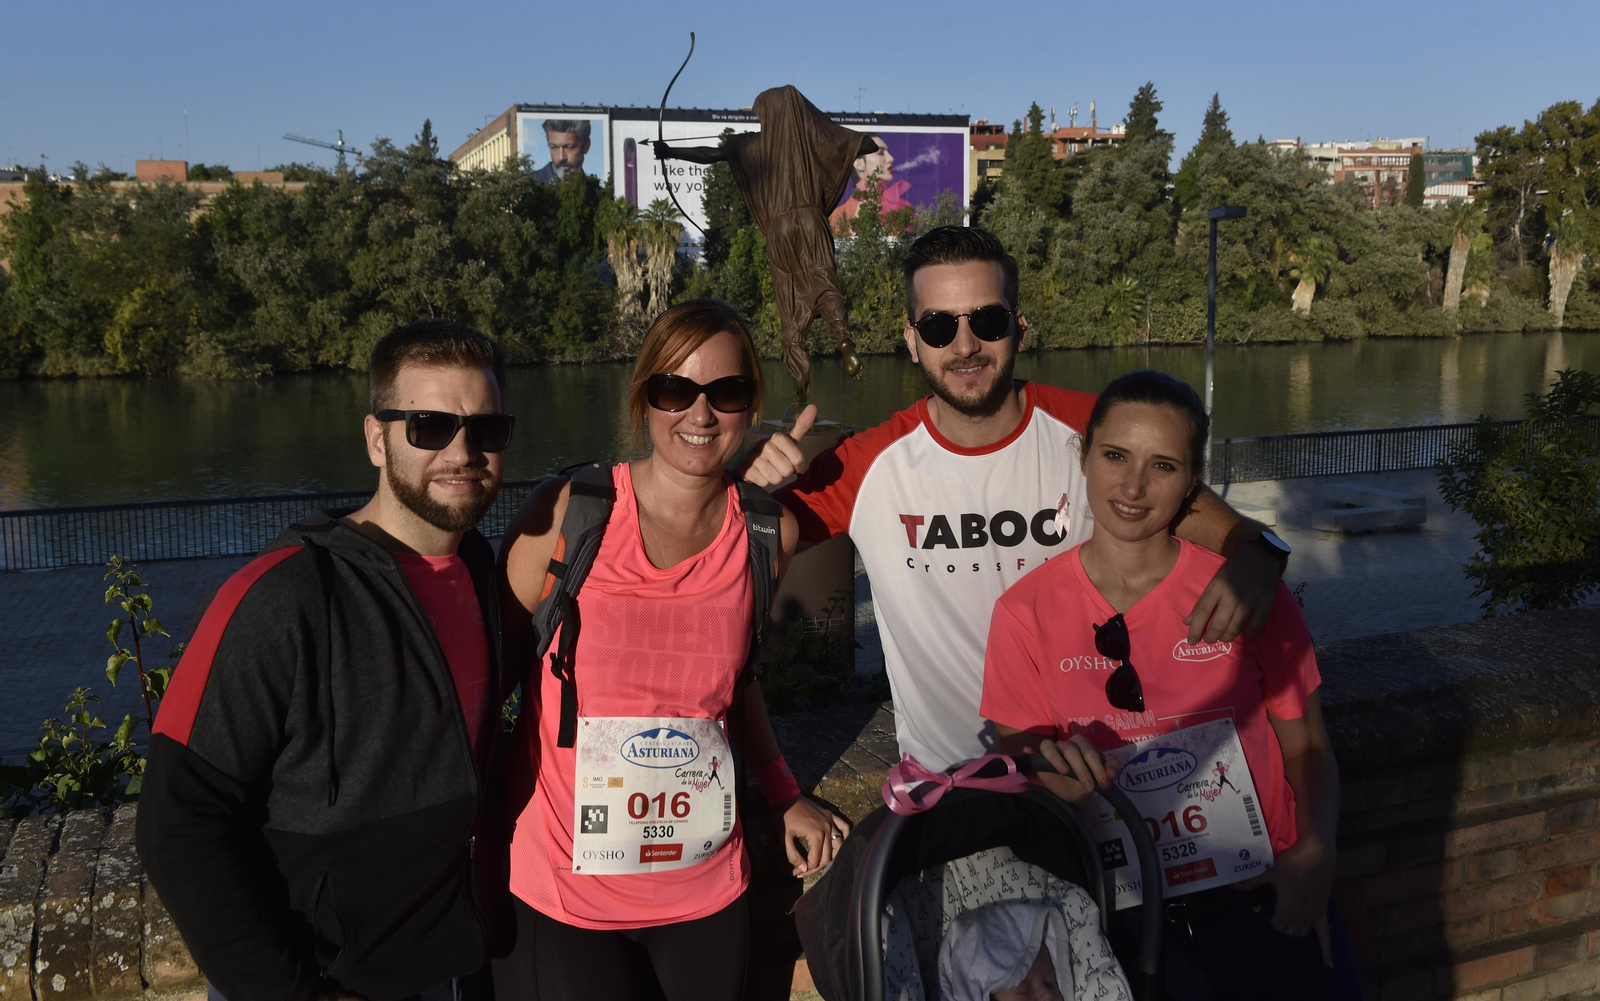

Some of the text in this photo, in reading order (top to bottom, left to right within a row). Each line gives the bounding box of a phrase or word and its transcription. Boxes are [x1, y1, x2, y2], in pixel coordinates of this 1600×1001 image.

[899, 508, 1067, 549] TABOO
[627, 742, 695, 758] ASTURIANA
[675, 768, 703, 778] Carrera
[1125, 759, 1192, 788] ASTURIANA
[1177, 779, 1209, 793] Carrera
[1200, 787, 1222, 803] Mujer
[627, 792, 690, 819] 016
[643, 825, 674, 839] 5330
[582, 850, 625, 860] OYSHO
[1162, 842, 1197, 861] 5328
[1180, 866, 1209, 877] Santander
[1234, 860, 1262, 872] ZURICH
[1113, 881, 1142, 895] OYSH
